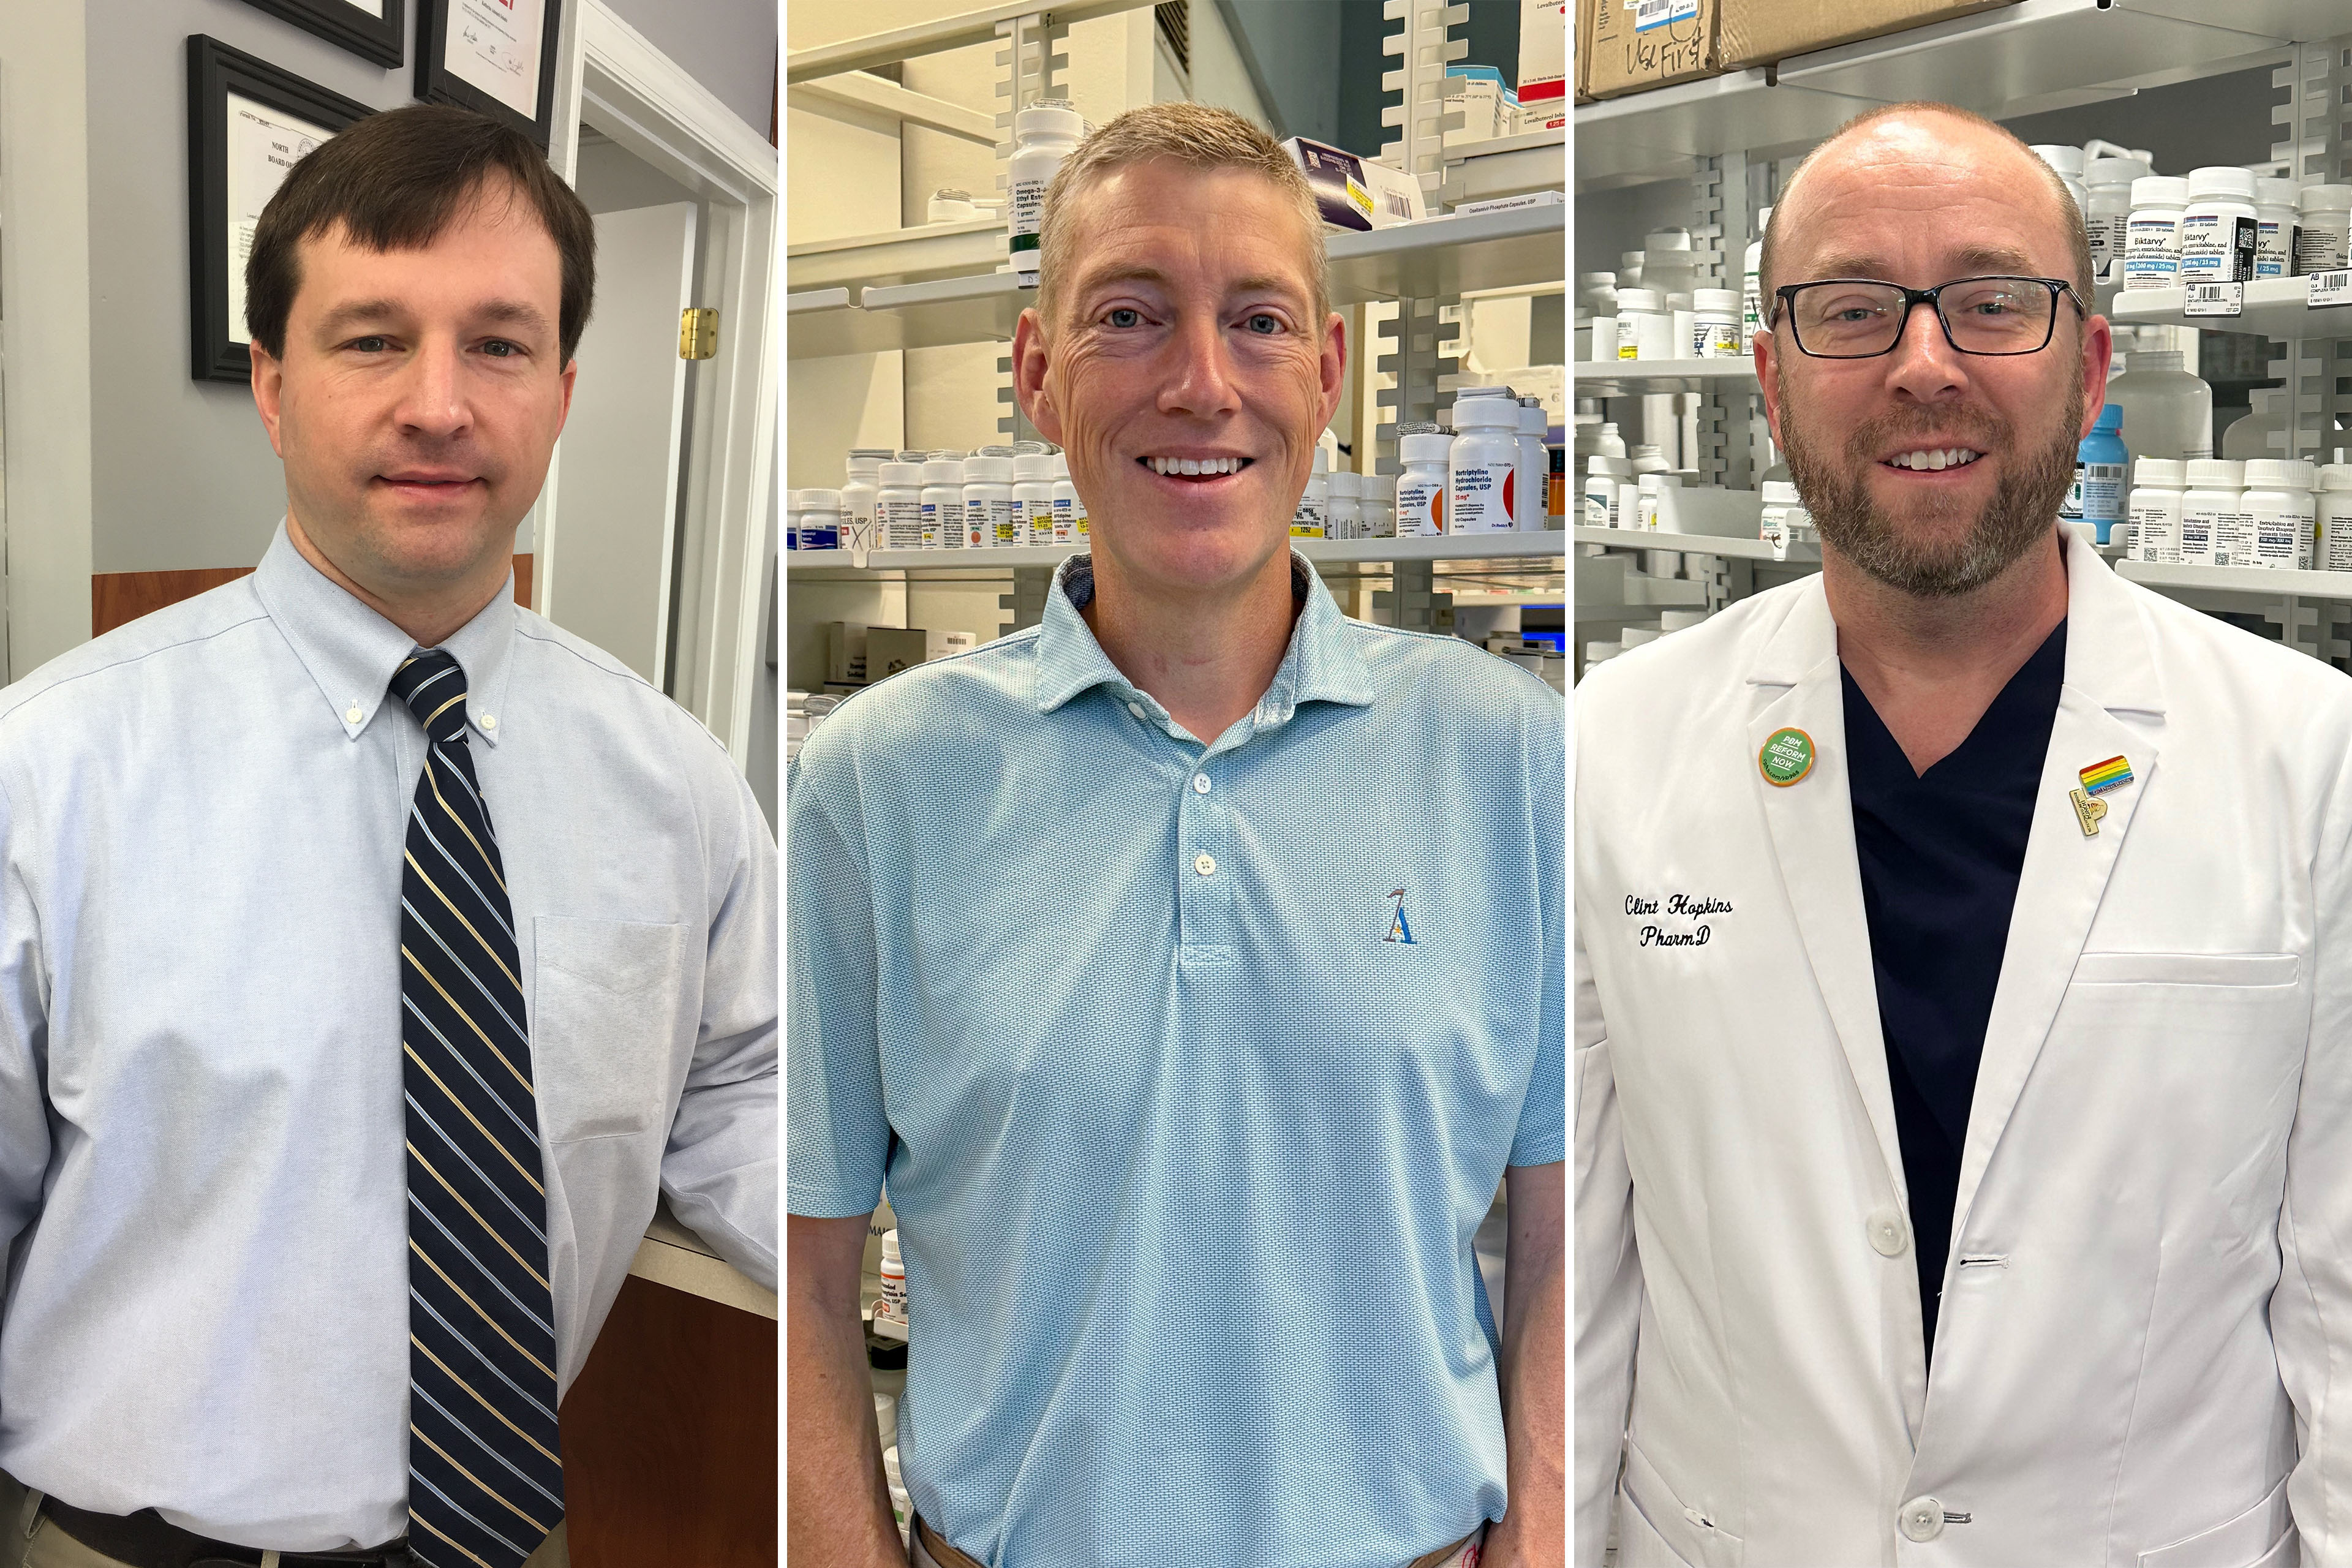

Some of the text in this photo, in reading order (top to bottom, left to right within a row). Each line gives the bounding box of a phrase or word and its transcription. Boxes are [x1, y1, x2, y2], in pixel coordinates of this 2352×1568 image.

[272, 141, 288, 154] NORTH
[268, 154, 285, 167] BOARD
[2310, 273, 2320, 281] AB
[1455, 476, 1492, 484] Hydrochloride
[1782, 736, 1803, 747] PBM
[1770, 744, 1806, 761] REFORM
[1772, 756, 1795, 768] NOW
[1625, 894, 1733, 921] Clint Hopkins
